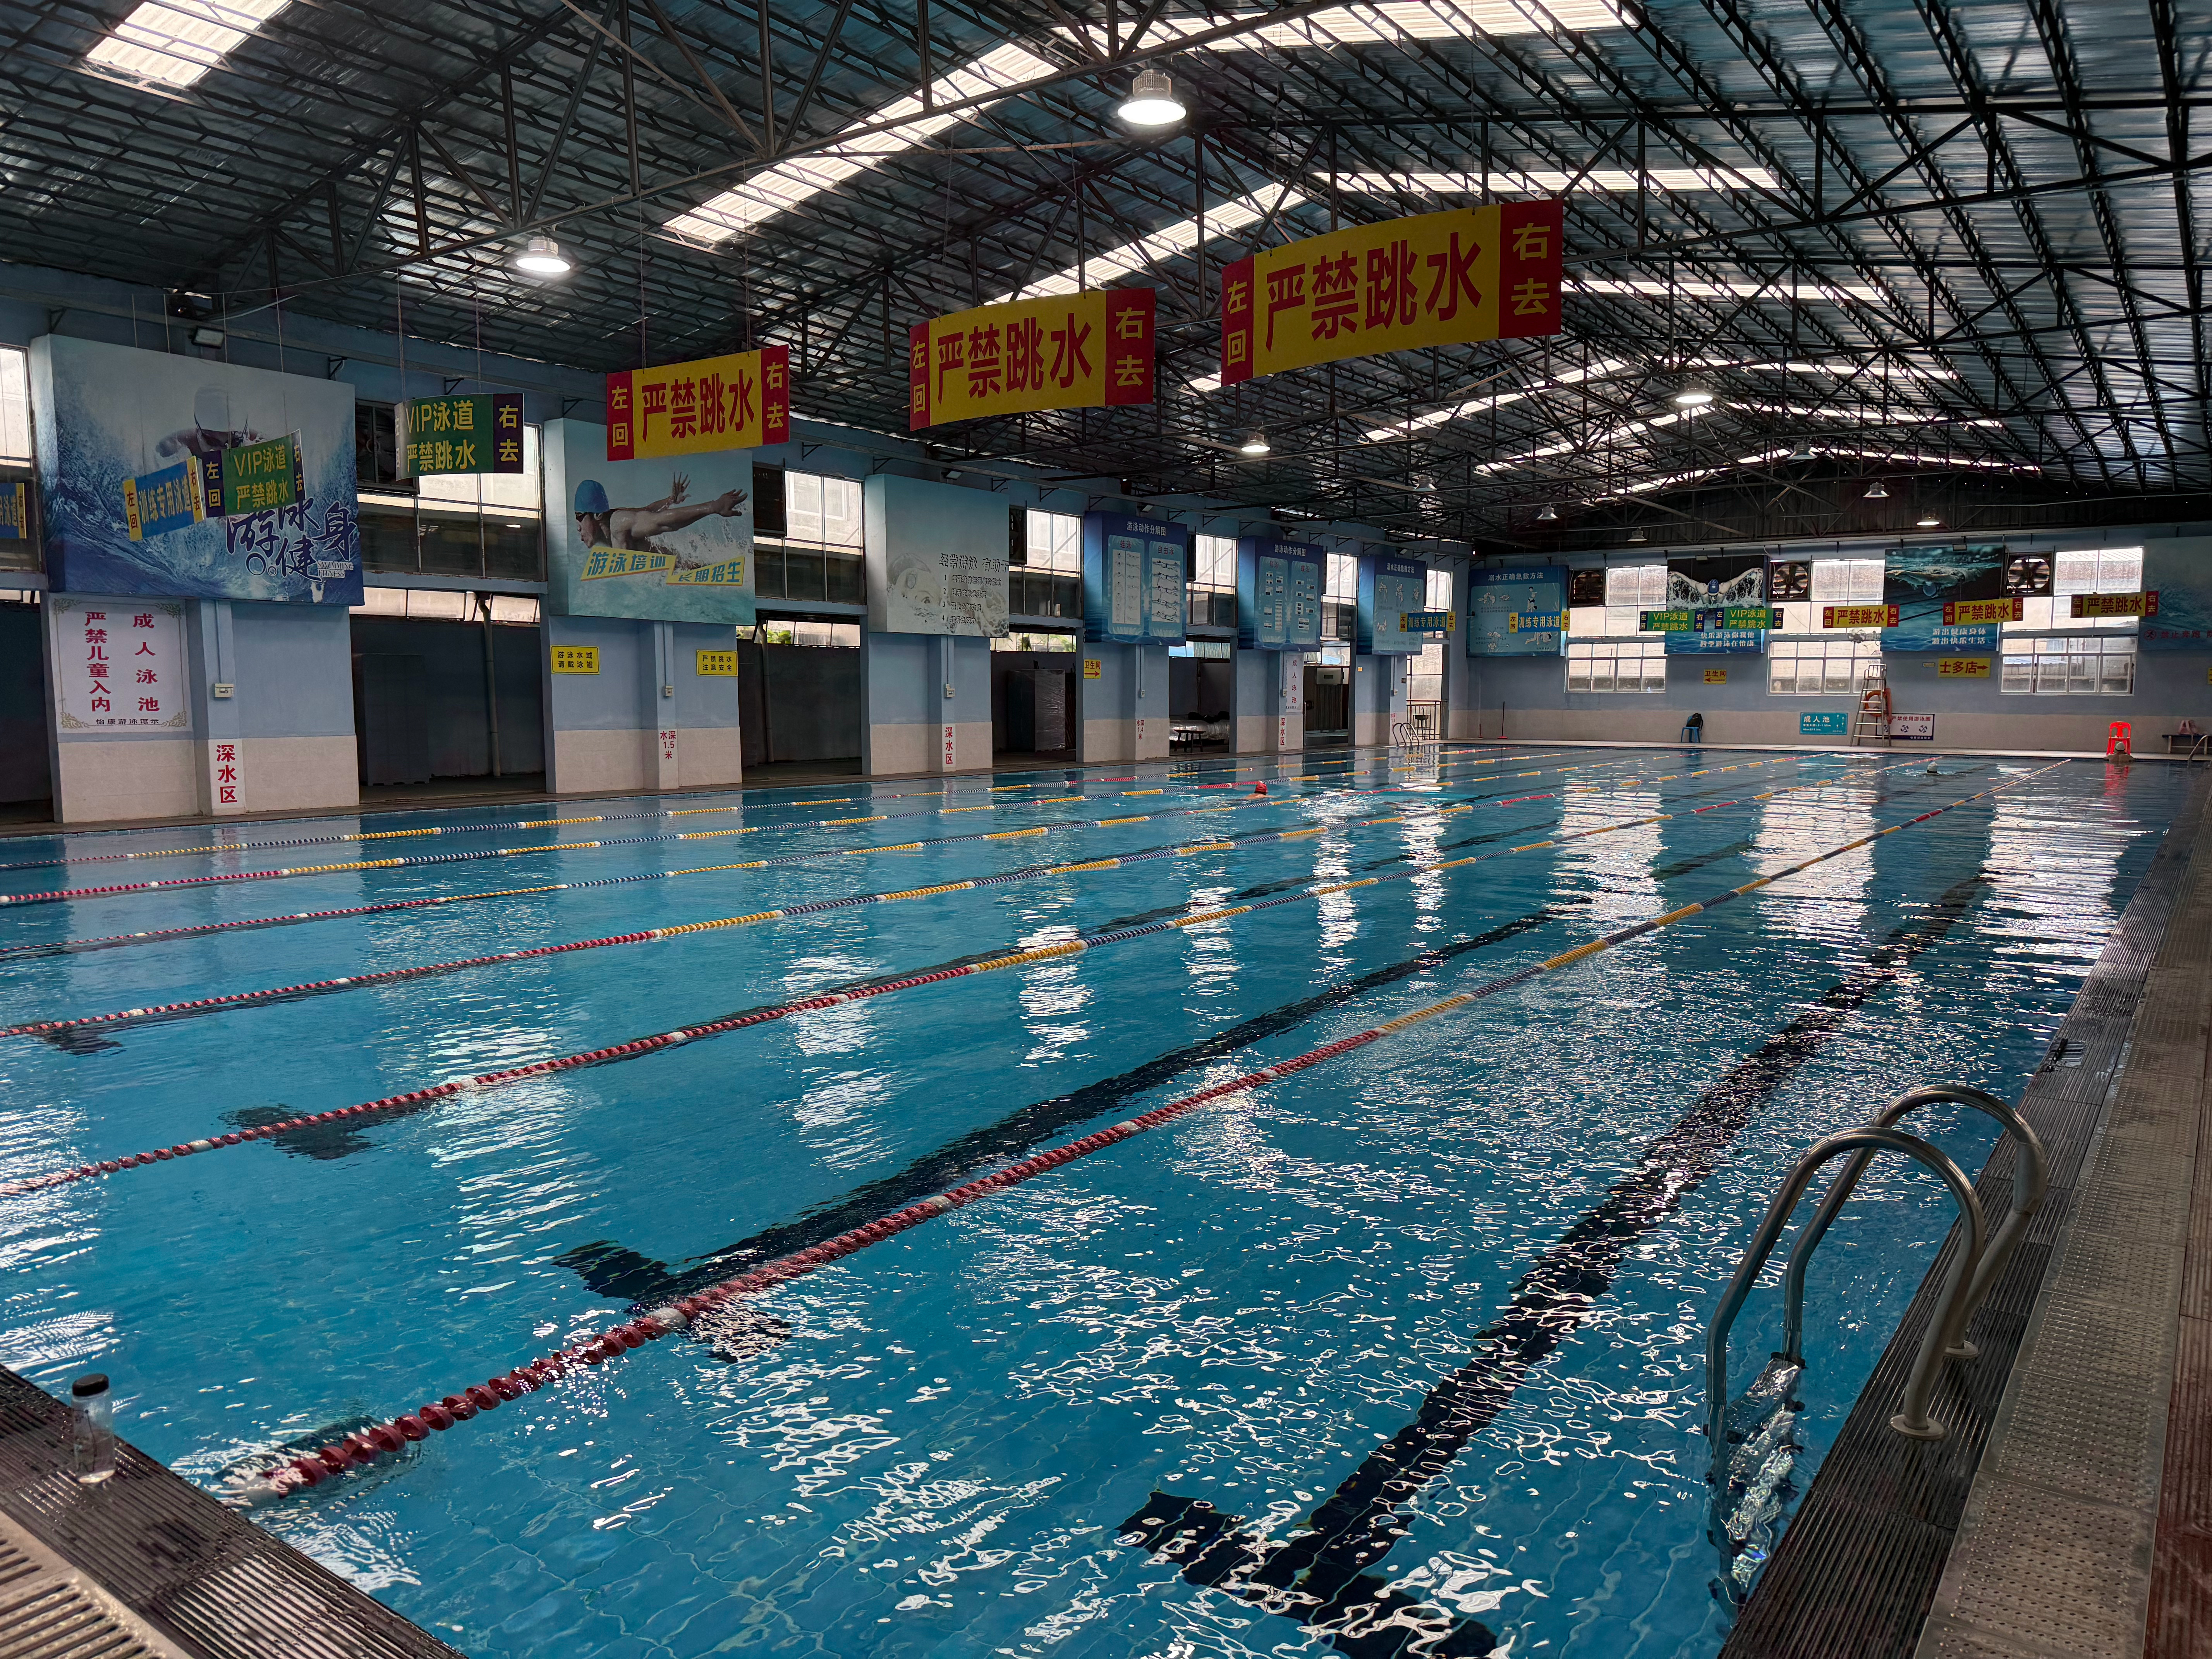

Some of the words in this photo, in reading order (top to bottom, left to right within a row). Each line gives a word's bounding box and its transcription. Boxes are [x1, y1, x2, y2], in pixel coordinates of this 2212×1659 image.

[1511, 223, 1550, 316] 右去
[1266, 232, 1482, 352] 严禁跳水
[1227, 280, 1247, 366] 左回
[1115, 307, 1145, 386] 右去
[938, 313, 1092, 405] 严禁跳水
[913, 341, 926, 414] 左回
[766, 362, 784, 429] 右去
[641, 369, 754, 442] 严禁跳水
[405, 400, 474, 434] VIP泳道
[612, 386, 628, 447] 左回
[499, 405, 519, 462] 右去
[234, 444, 286, 477] VIP泳道
[407, 440, 476, 473] 严禁跳水
[294, 444, 303, 491] 右去
[190, 472, 200, 510] 右去
[206, 462, 220, 507] 左回
[139, 475, 192, 524] 训练专用泳道
[236, 477, 289, 510] 严禁跳水
[127, 491, 137, 530] 左回
[1127, 521, 1166, 536] 游泳动作分解图
[318, 561, 354, 570] SWIMMING
[587, 551, 666, 576] 游泳培训
[939, 553, 977, 570] 经常游泳
[678, 561, 741, 582] 长期招生
[1488, 572, 1544, 581] 溺水正确急救方法
[1730, 609, 1766, 618] VIP泳道
[1958, 603, 2009, 621] 严禁跳水
[2014, 601, 2022, 619] 右去
[2087, 596, 2142, 614] 严禁跳水
[1401, 617, 1405, 628] 左回
[1408, 616, 1446, 628] 训练专用泳道
[1449, 615, 1454, 628] 右去
[1510, 616, 1516, 629] 左回
[1519, 615, 1560, 629] 训练专用泳道
[1563, 614, 1569, 628] 右去
[1640, 614, 1647, 629] 左回
[1654, 612, 1687, 620] VIP泳道
[1696, 614, 1703, 629] 右去
[1716, 611, 1723, 626] 左回
[1775, 611, 1782, 627] 右去
[1825, 610, 1832, 626] 左回
[1837, 608, 1885, 625] 严禁跳水
[1889, 608, 1897, 624] 右去
[1945, 606, 1953, 622] 左回
[1652, 622, 1687, 631] 严禁跳水
[1729, 620, 1765, 629] 严禁跳水
[1932, 627, 1986, 635] 游出健康身体
[84, 611, 112, 712] 严禁儿童入内
[132, 613, 160, 711] 成人泳池
[1085, 661, 1101, 670] 卫生间
[1940, 661, 1977, 674] 士多店
[660, 731, 676, 739] 水深
[665, 750, 673, 759] 米
[216, 744, 238, 803] 深水区
